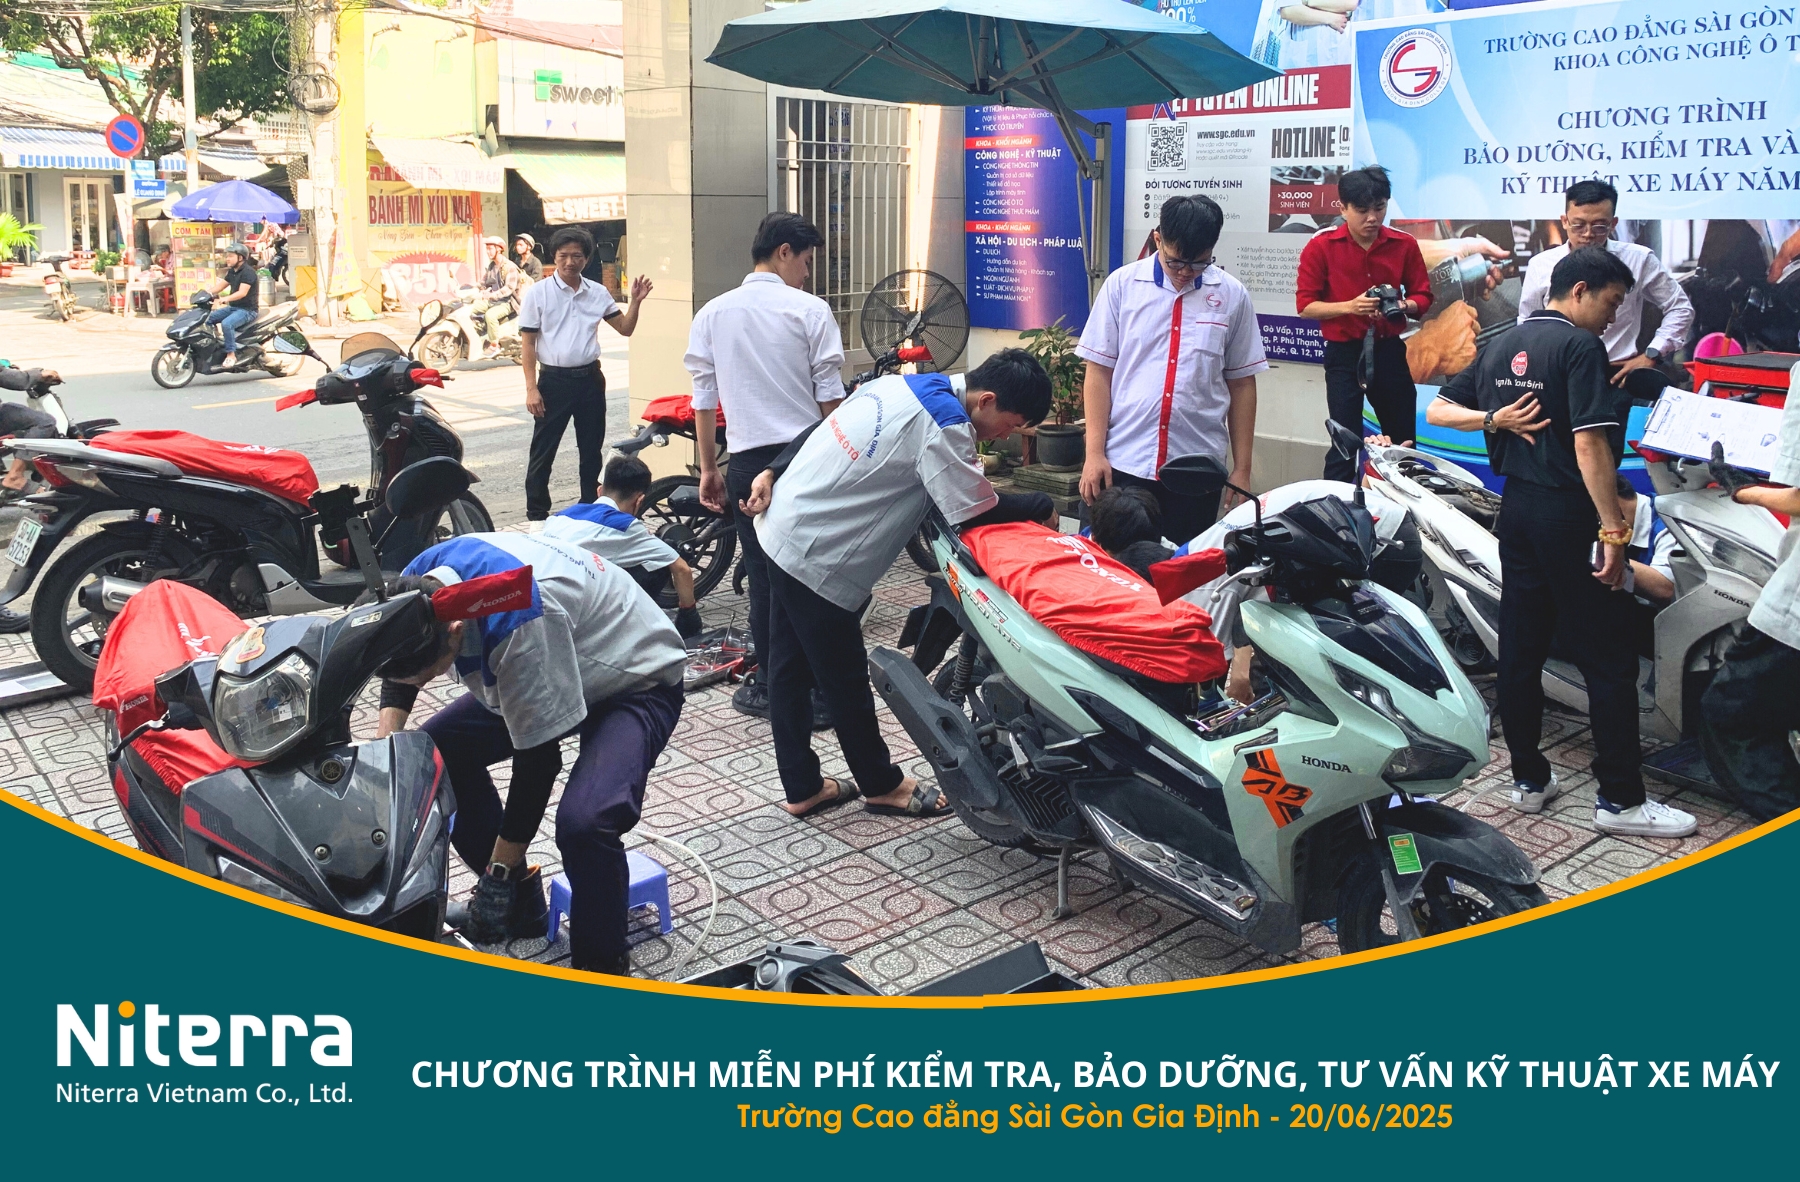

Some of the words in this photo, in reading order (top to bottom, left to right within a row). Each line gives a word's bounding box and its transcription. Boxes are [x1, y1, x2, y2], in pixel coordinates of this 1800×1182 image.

[1483, 32, 1567, 54] TRƯỜNG
[1573, 26, 1618, 45] CAO
[1624, 14, 1687, 41] ĐẲNG
[1693, 11, 1731, 34] SÀI
[1740, 5, 1796, 28] GÒN
[1553, 53, 1610, 71] KHOA
[1617, 45, 1679, 65] CÔNG
[1686, 36, 1752, 60] NGHỆ
[1759, 32, 1778, 53] Ô
[1252, 74, 1320, 110] ONLINE
[1557, 105, 1670, 130] CHƯƠNG
[1678, 97, 1768, 124] TRÌNH
[1197, 128, 1255, 139] www.sgc.edu.vn
[1271, 126, 1336, 158] HOTLINE
[975, 150, 998, 160] CÔNG
[999, 149, 1020, 161] NGHỆ
[1025, 148, 1035, 159] KỸ
[1037, 147, 1061, 159] THUẬT
[1463, 141, 1510, 165] BẢO
[1516, 139, 1612, 164] DƯỠNG,
[1620, 130, 1687, 160] KIỂM
[1696, 136, 1751, 158] TRA
[1761, 129, 1800, 155] VÀ
[1162, 178, 1191, 191] TƯỢNG
[1194, 176, 1221, 189] TUYỂN
[1222, 179, 1243, 188] SINH
[1501, 172, 1531, 194] KỸ
[1627, 172, 1662, 194] XE
[1669, 166, 1730, 193] MÁY
[1736, 166, 1800, 191] NĂM
[368, 189, 404, 225] BÁNH
[408, 188, 424, 224] MÌ
[427, 189, 449, 225] XÍU
[1296, 200, 1310, 208] VIÊN
[975, 223, 991, 231] KHOA
[975, 235, 986, 245] XÃ
[988, 234, 1001, 247] HỘI
[1007, 238, 1018, 246] DU
[1020, 238, 1037, 248] LỊCH
[1043, 236, 1066, 247] PHÁP
[1067, 237, 1083, 250] LUẬ
[1280, 336, 1294, 344] Phú
[1295, 327, 1305, 336] TP.
[483, 590, 523, 608] HONDA
[1714, 589, 1751, 608] HONDA
[1301, 755, 1352, 773] HONDA
